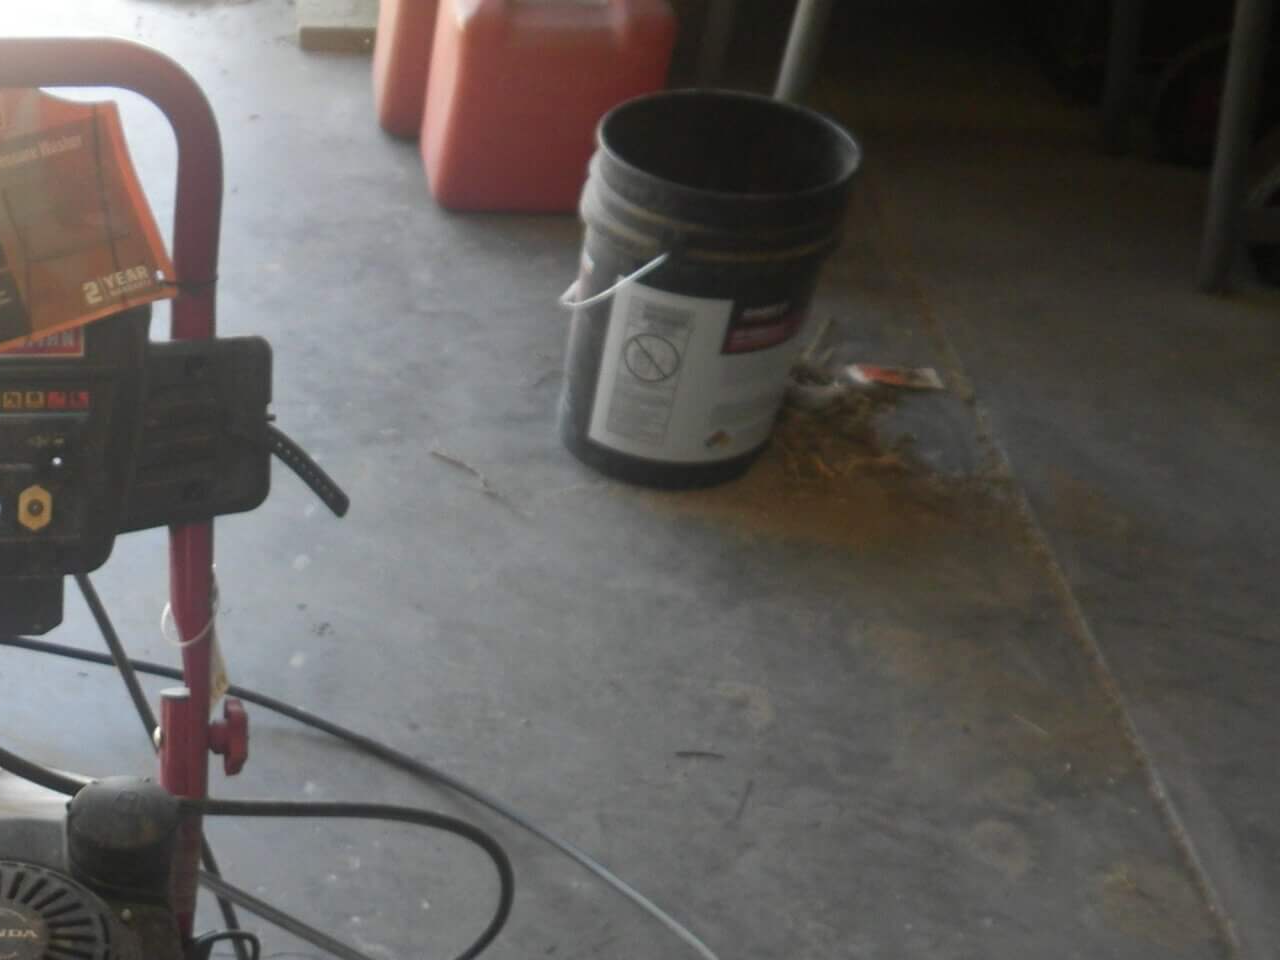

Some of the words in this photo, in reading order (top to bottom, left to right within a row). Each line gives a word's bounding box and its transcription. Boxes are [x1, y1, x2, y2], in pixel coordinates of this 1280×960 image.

[39, 134, 82, 159] Washer
[82, 281, 103, 305] 2
[104, 265, 150, 289] YEAR
